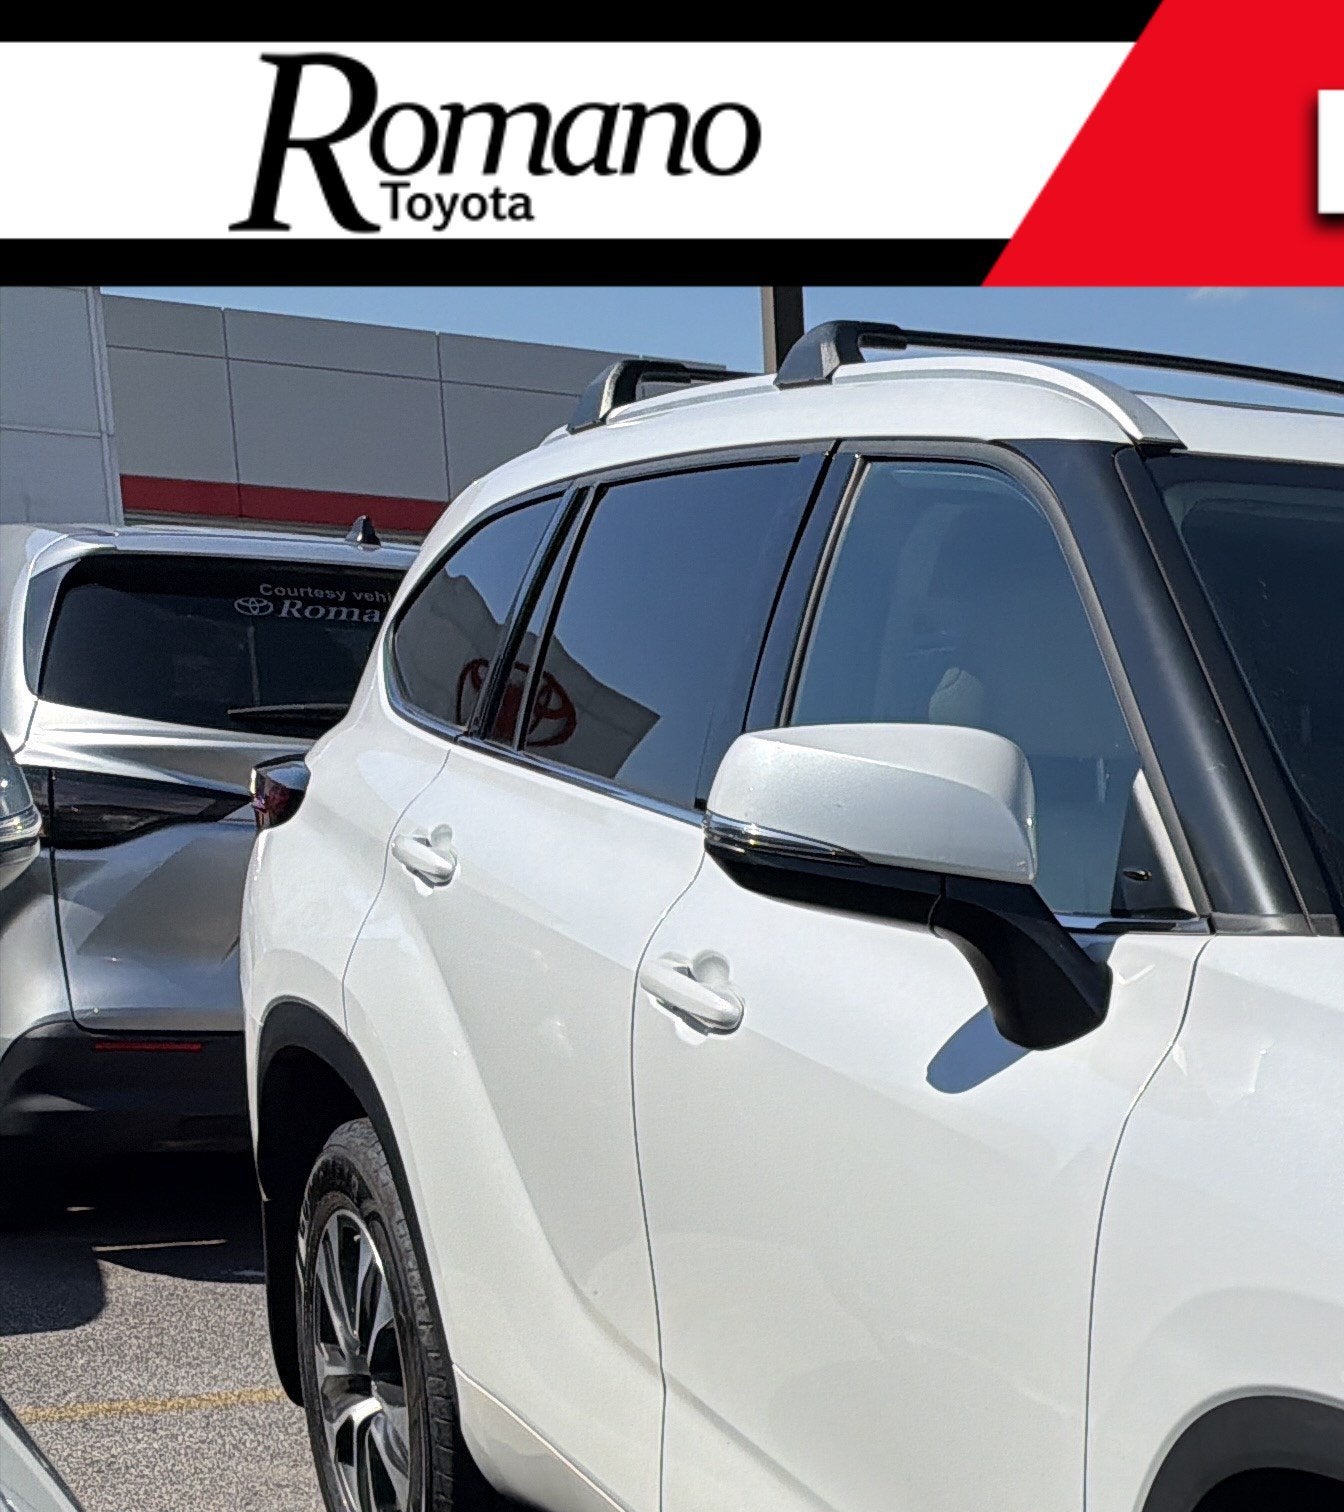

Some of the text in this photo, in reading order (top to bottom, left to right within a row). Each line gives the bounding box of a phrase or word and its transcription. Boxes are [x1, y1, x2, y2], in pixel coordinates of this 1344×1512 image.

[259, 583, 394, 604] Courtesy vehi
[278, 599, 382, 623] Roma
